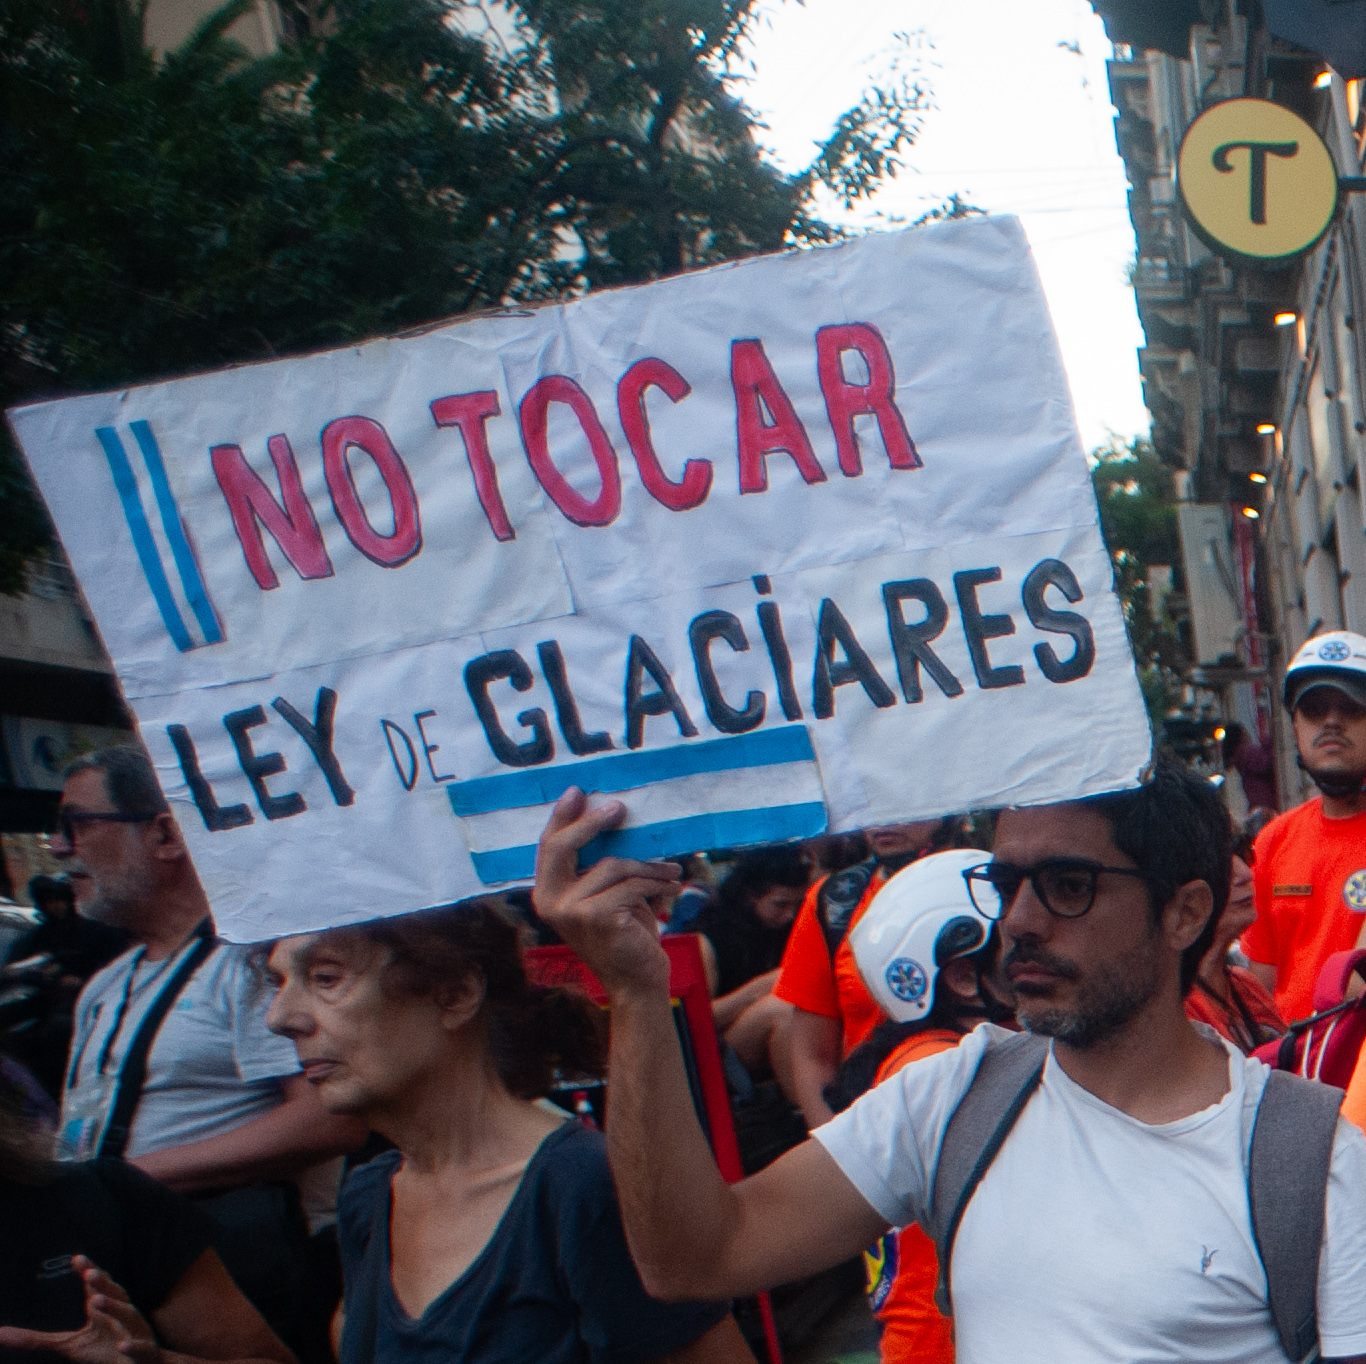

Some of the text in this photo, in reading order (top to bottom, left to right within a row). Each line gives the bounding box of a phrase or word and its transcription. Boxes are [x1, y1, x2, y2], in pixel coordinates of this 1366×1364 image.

[1210, 139, 1299, 226] T
[210, 321, 924, 591] NO TOCAR
[167, 685, 356, 831] LEY
[381, 709, 456, 791] DE
